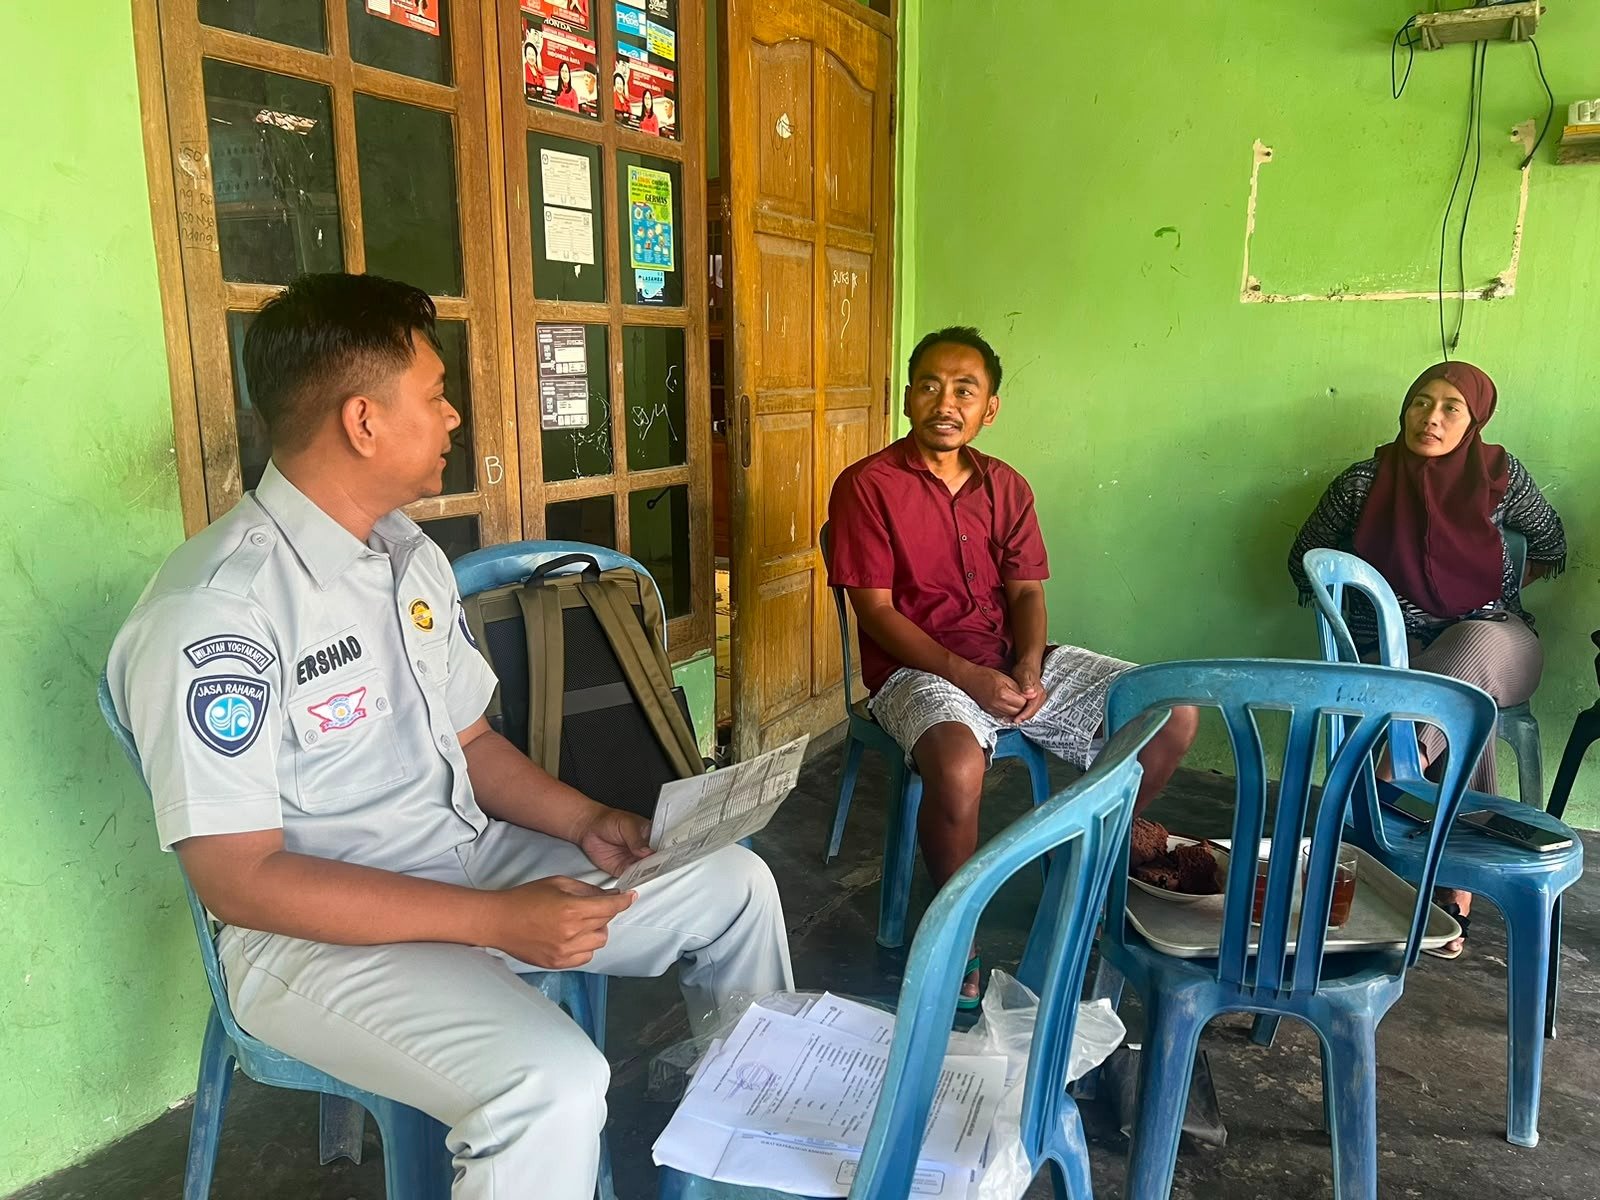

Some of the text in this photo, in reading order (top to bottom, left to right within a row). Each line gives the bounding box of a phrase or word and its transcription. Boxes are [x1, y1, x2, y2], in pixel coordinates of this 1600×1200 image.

[645, 194, 668, 204] GERMAS
[484, 456, 504, 484] B
[194, 642, 268, 666] WILAYAH YOGYAKARTA
[296, 635, 362, 686] ERSHAD
[198, 684, 264, 701] JASA RAHARJA
[1068, 708, 1096, 732] TO YOU
